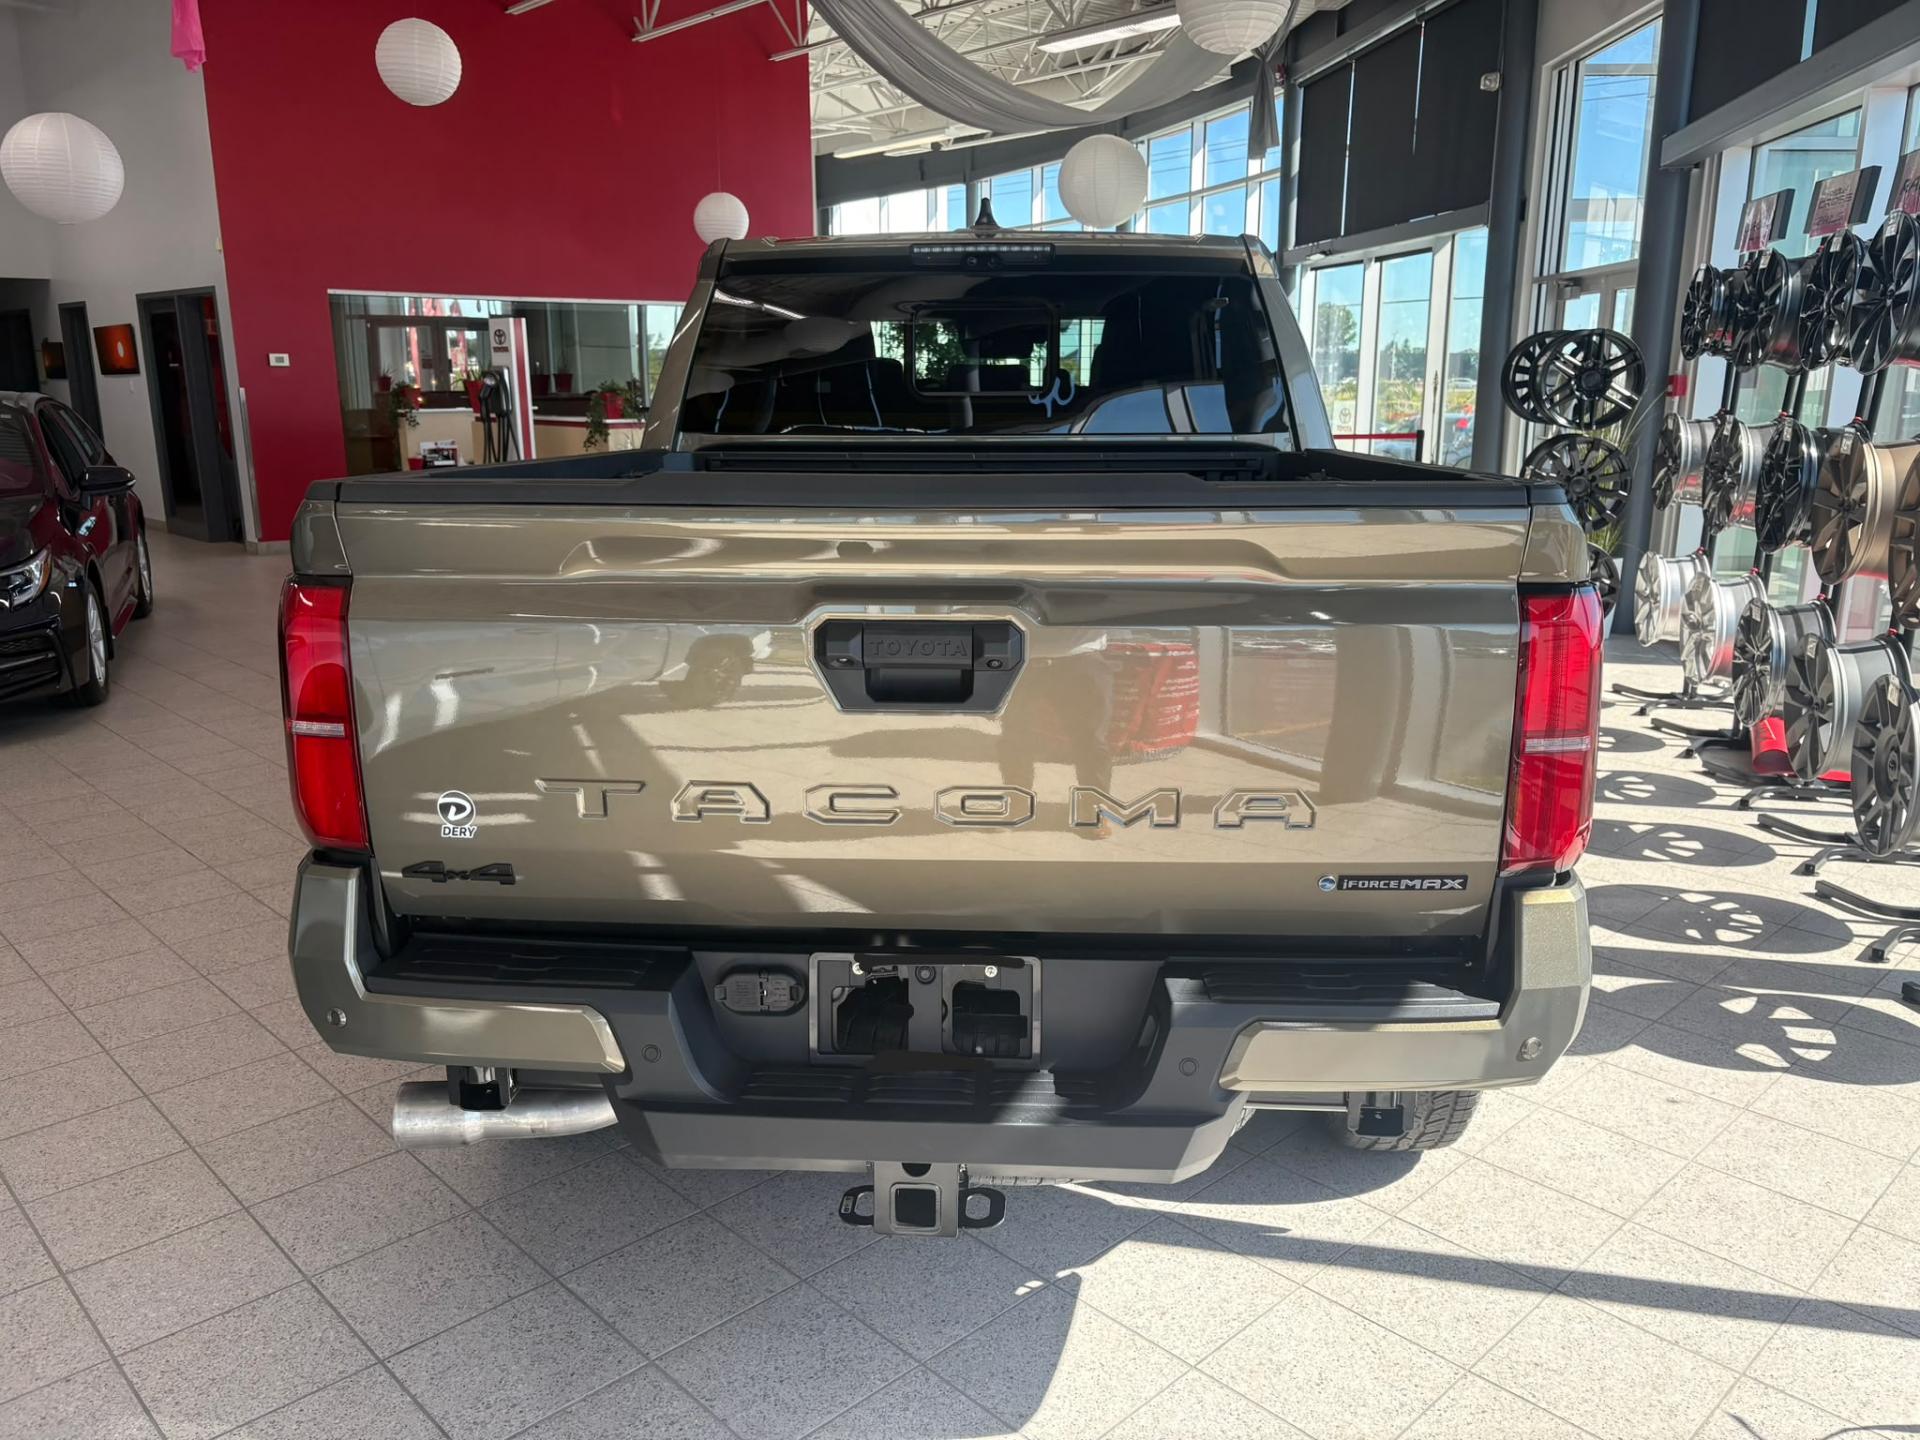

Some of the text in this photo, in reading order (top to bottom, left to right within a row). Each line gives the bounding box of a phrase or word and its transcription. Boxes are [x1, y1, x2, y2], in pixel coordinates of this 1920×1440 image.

[868, 638, 968, 658] TOYOTA
[534, 778, 1318, 831] TACOMA
[442, 825, 476, 838] DERY
